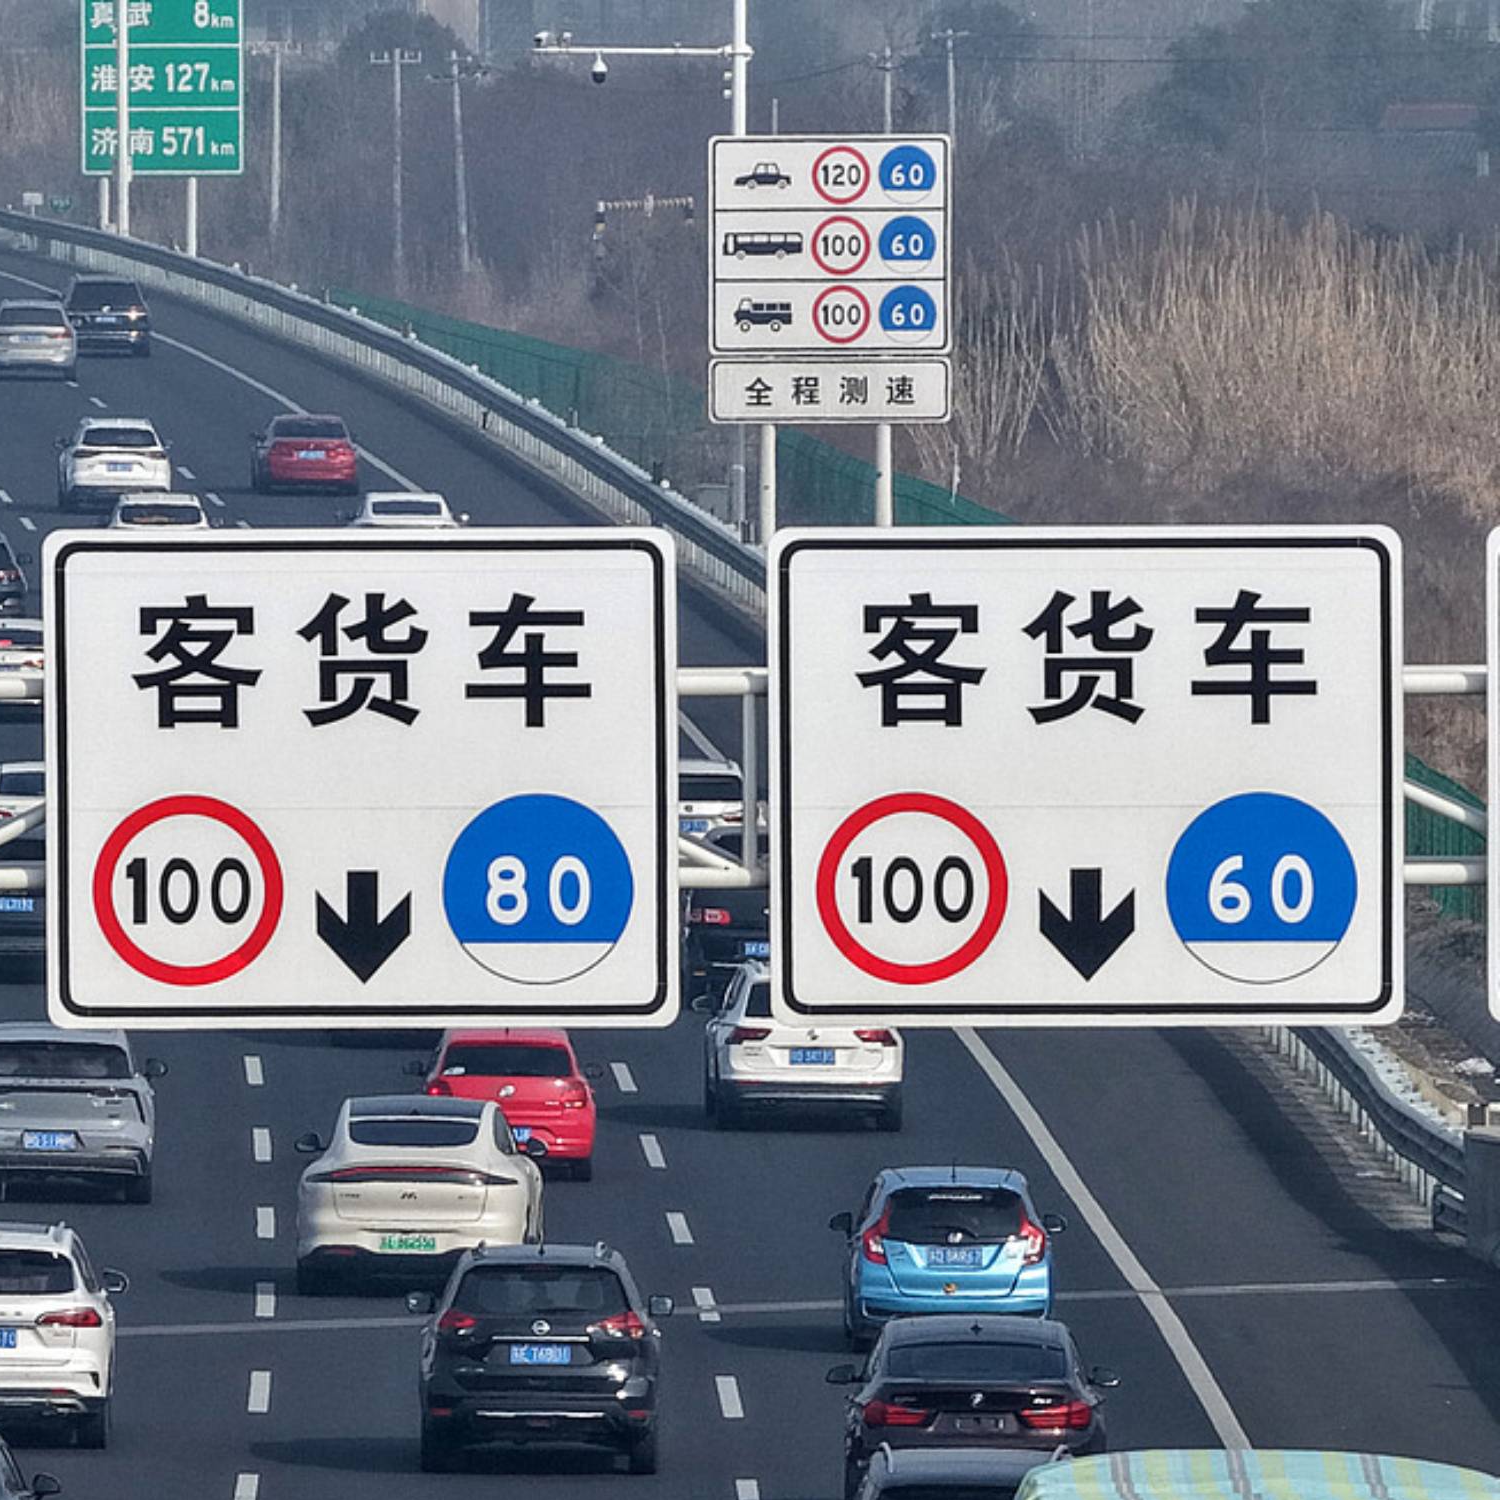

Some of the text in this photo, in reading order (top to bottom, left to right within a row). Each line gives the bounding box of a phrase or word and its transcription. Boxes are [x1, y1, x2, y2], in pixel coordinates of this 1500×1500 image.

[91, 64, 155, 92] 淮安
[91, 127, 155, 156] 济南
[821, 165, 861, 186] 120
[890, 164, 924, 186] 60
[821, 235, 861, 256] 100
[890, 234, 924, 256] 60
[822, 304, 861, 325] 100
[891, 303, 924, 326] 60
[745, 375, 916, 406] 全程测速
[131, 593, 592, 728] 客货车
[855, 590, 1317, 727] 客货车
[126, 856, 251, 925] 100
[485, 855, 592, 925] 80
[851, 856, 974, 924] 100
[1208, 854, 1314, 925] 60
